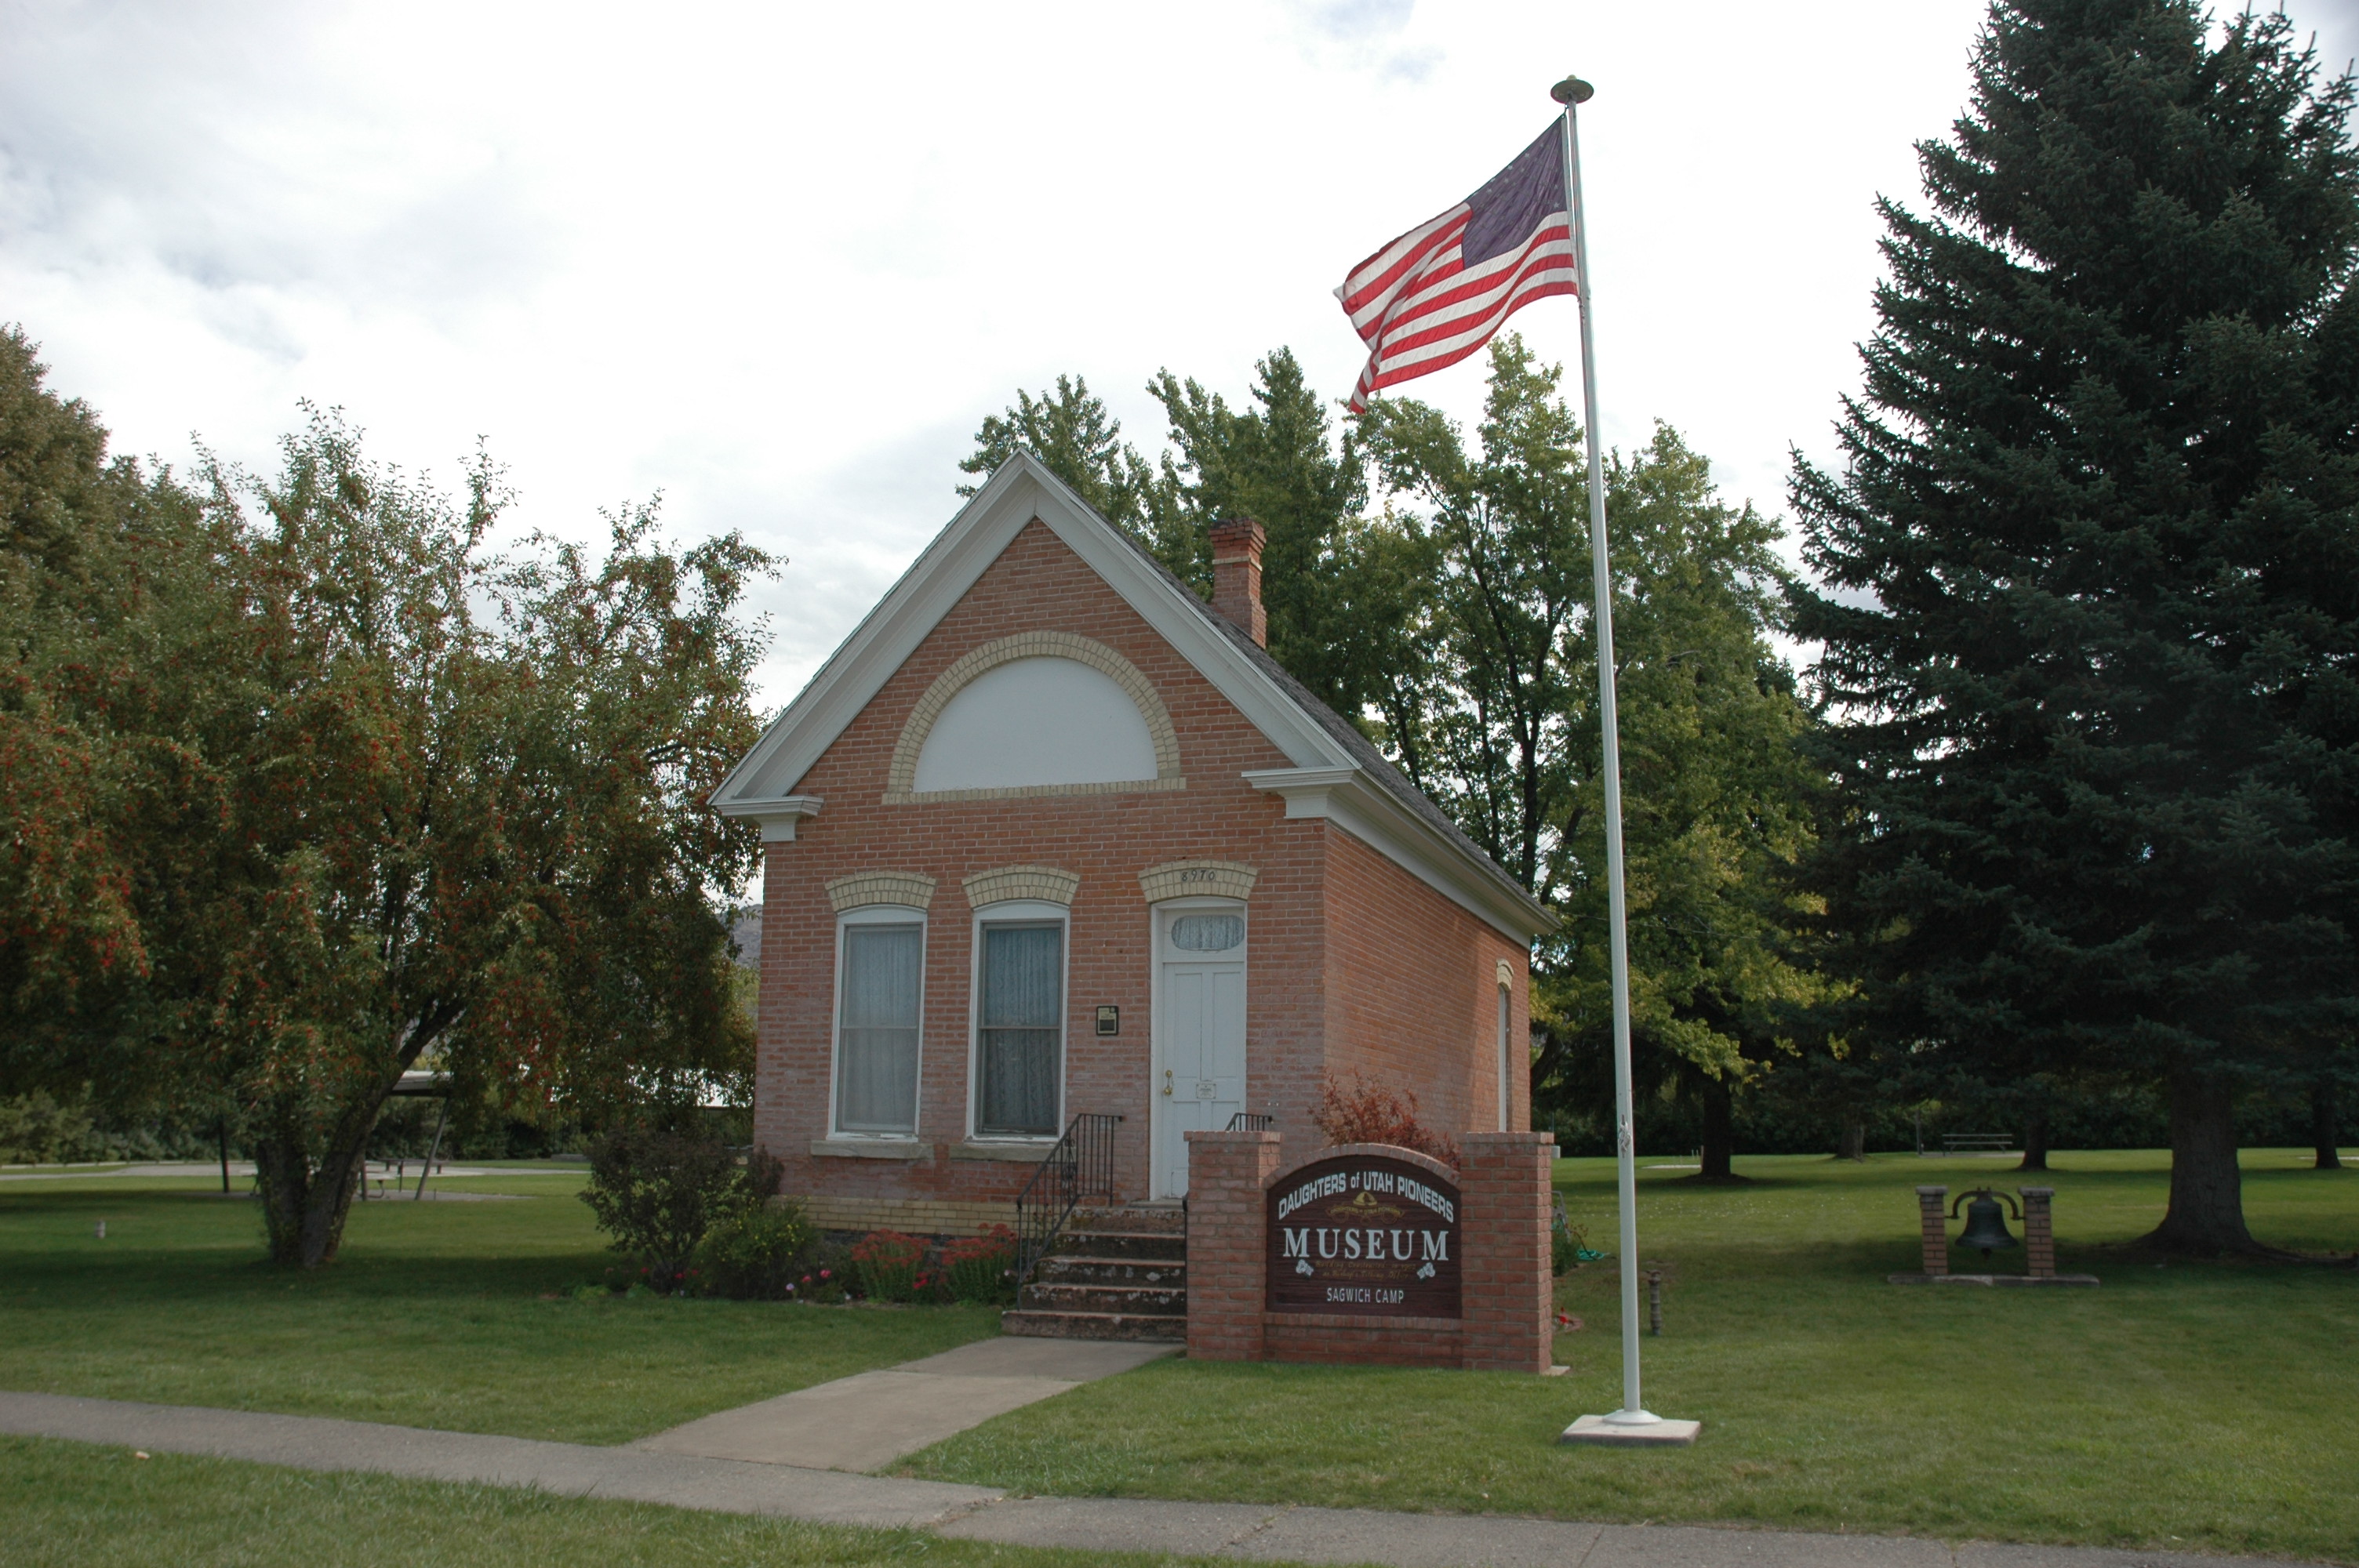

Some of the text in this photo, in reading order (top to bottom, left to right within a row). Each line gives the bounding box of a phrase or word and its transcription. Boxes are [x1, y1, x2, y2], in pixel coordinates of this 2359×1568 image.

[1181, 869, 1215, 882] 8970
[1278, 1171, 1454, 1223] DAUGHTERS of UTAH PIONEERS
[1282, 1228, 1449, 1261] MUSEUM
[1326, 1287, 1405, 1304] SAGWICH CAMP
